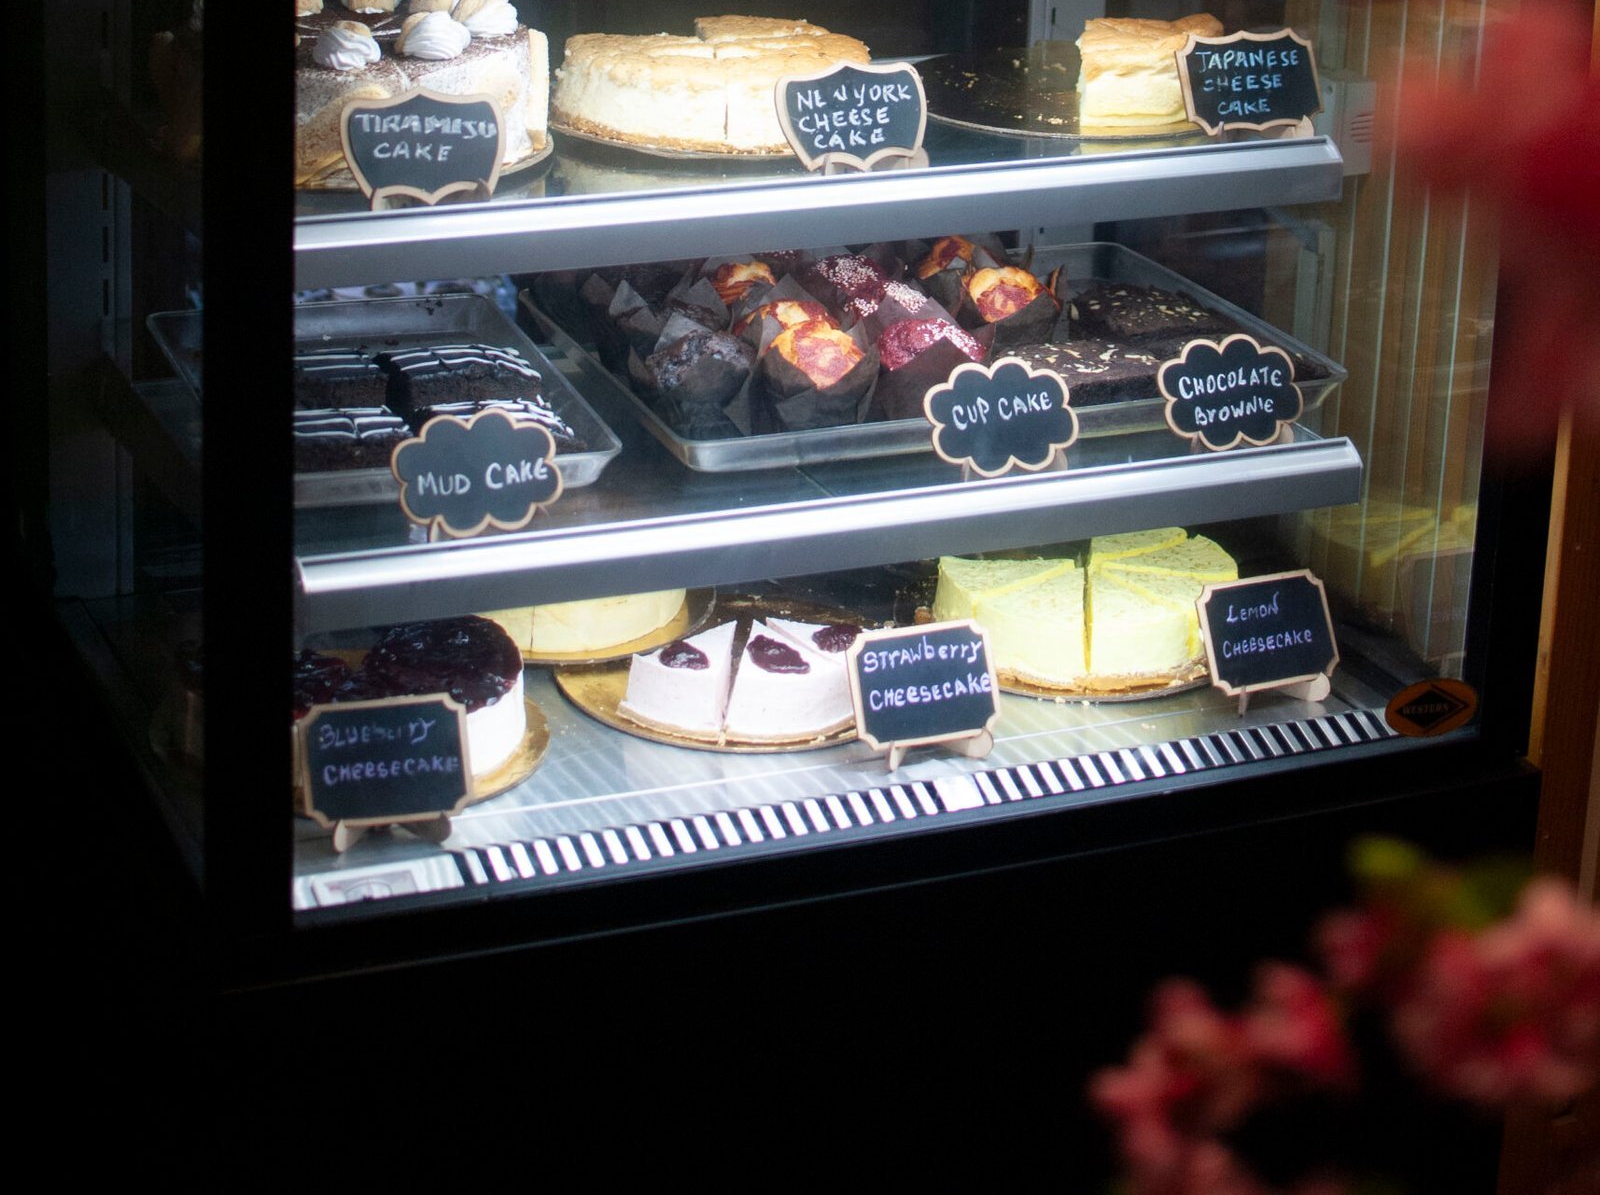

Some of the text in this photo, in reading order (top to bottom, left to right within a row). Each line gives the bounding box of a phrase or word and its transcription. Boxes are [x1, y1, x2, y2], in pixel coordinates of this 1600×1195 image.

[1194, 49, 1300, 73] JAPANESE
[853, 83, 912, 107] YORK
[1217, 98, 1272, 117] CAKE
[354, 113, 498, 140] TIRAMISU
[798, 106, 891, 133] CHEESE
[373, 141, 454, 162] CAKE
[813, 127, 887, 151] CAKE
[1178, 365, 1284, 400] CHOCOLATE
[951, 391, 1054, 431] CUP CAKE
[416, 456, 549, 497] MUD CAKE
[1225, 591, 1281, 624] LEMON
